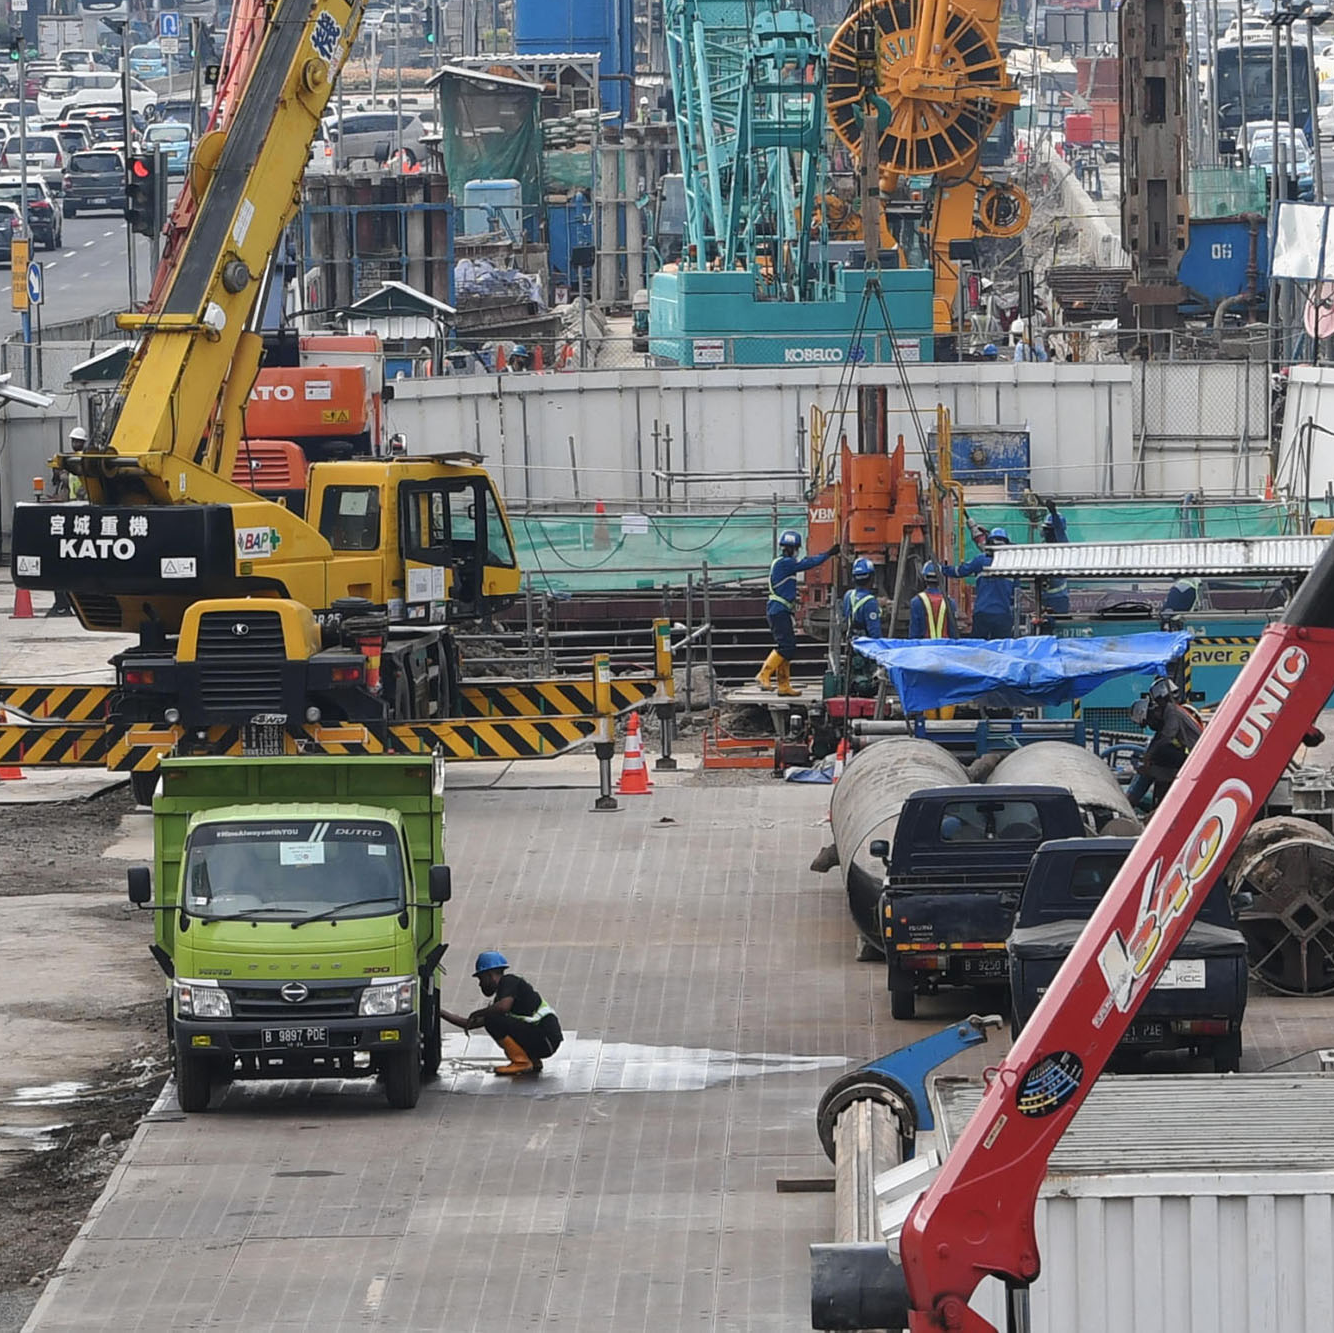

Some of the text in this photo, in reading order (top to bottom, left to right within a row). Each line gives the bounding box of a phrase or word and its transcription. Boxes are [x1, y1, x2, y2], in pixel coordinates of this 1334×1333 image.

[1211, 243, 1232, 260] 06
[784, 347, 844, 363] KOBELCO
[809, 507, 836, 524] YBM
[50, 514, 149, 537] 宮城重機
[244, 532, 269, 550] BAP
[59, 538, 136, 561] KATO
[1191, 648, 1236, 663] aver
[1227, 645, 1310, 761] UNIC
[334, 827, 384, 837] DUTRO
[362, 965, 390, 974] 300
[964, 960, 972, 971] B
[264, 1028, 327, 1043] B 9897 PDE
